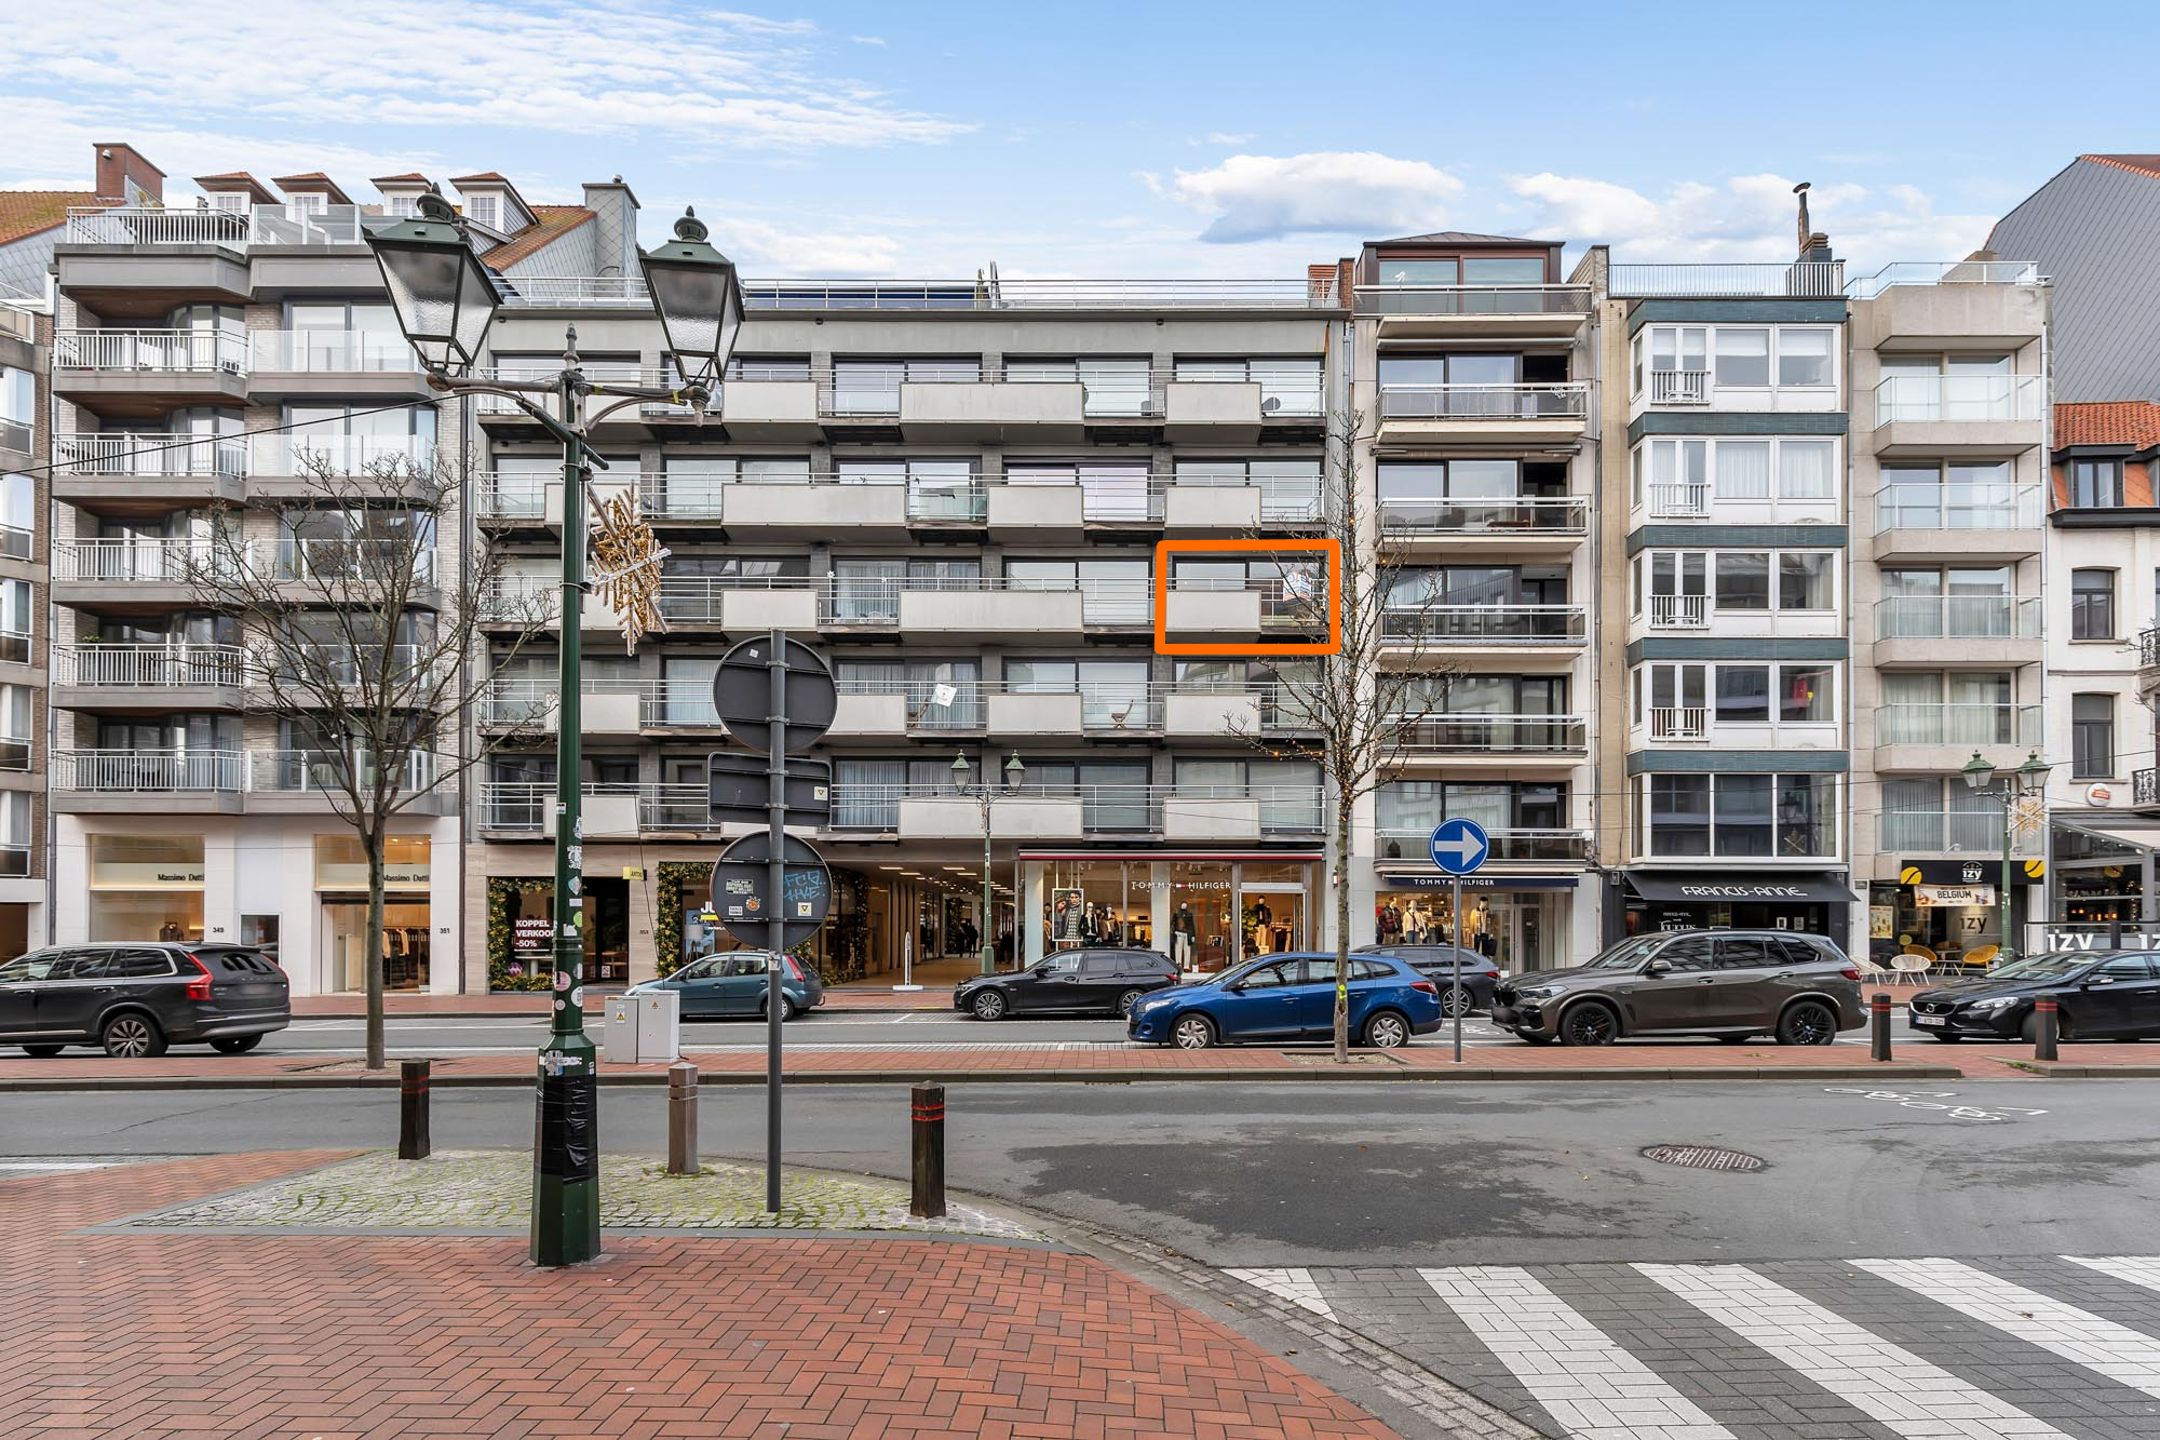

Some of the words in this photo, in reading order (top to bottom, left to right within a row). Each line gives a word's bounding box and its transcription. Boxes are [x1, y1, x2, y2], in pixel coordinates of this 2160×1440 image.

[383, 874, 410, 882] Massimo
[412, 874, 430, 882] Dutti
[1131, 881, 1173, 890] TOMMY
[1188, 881, 1231, 889] HILFIGER
[1681, 886, 1808, 896] FRANCIS-ANNE
[1936, 890, 1972, 899] BELGIUM
[515, 919, 550, 928] KOPPEL
[515, 939, 538, 947] -50%
